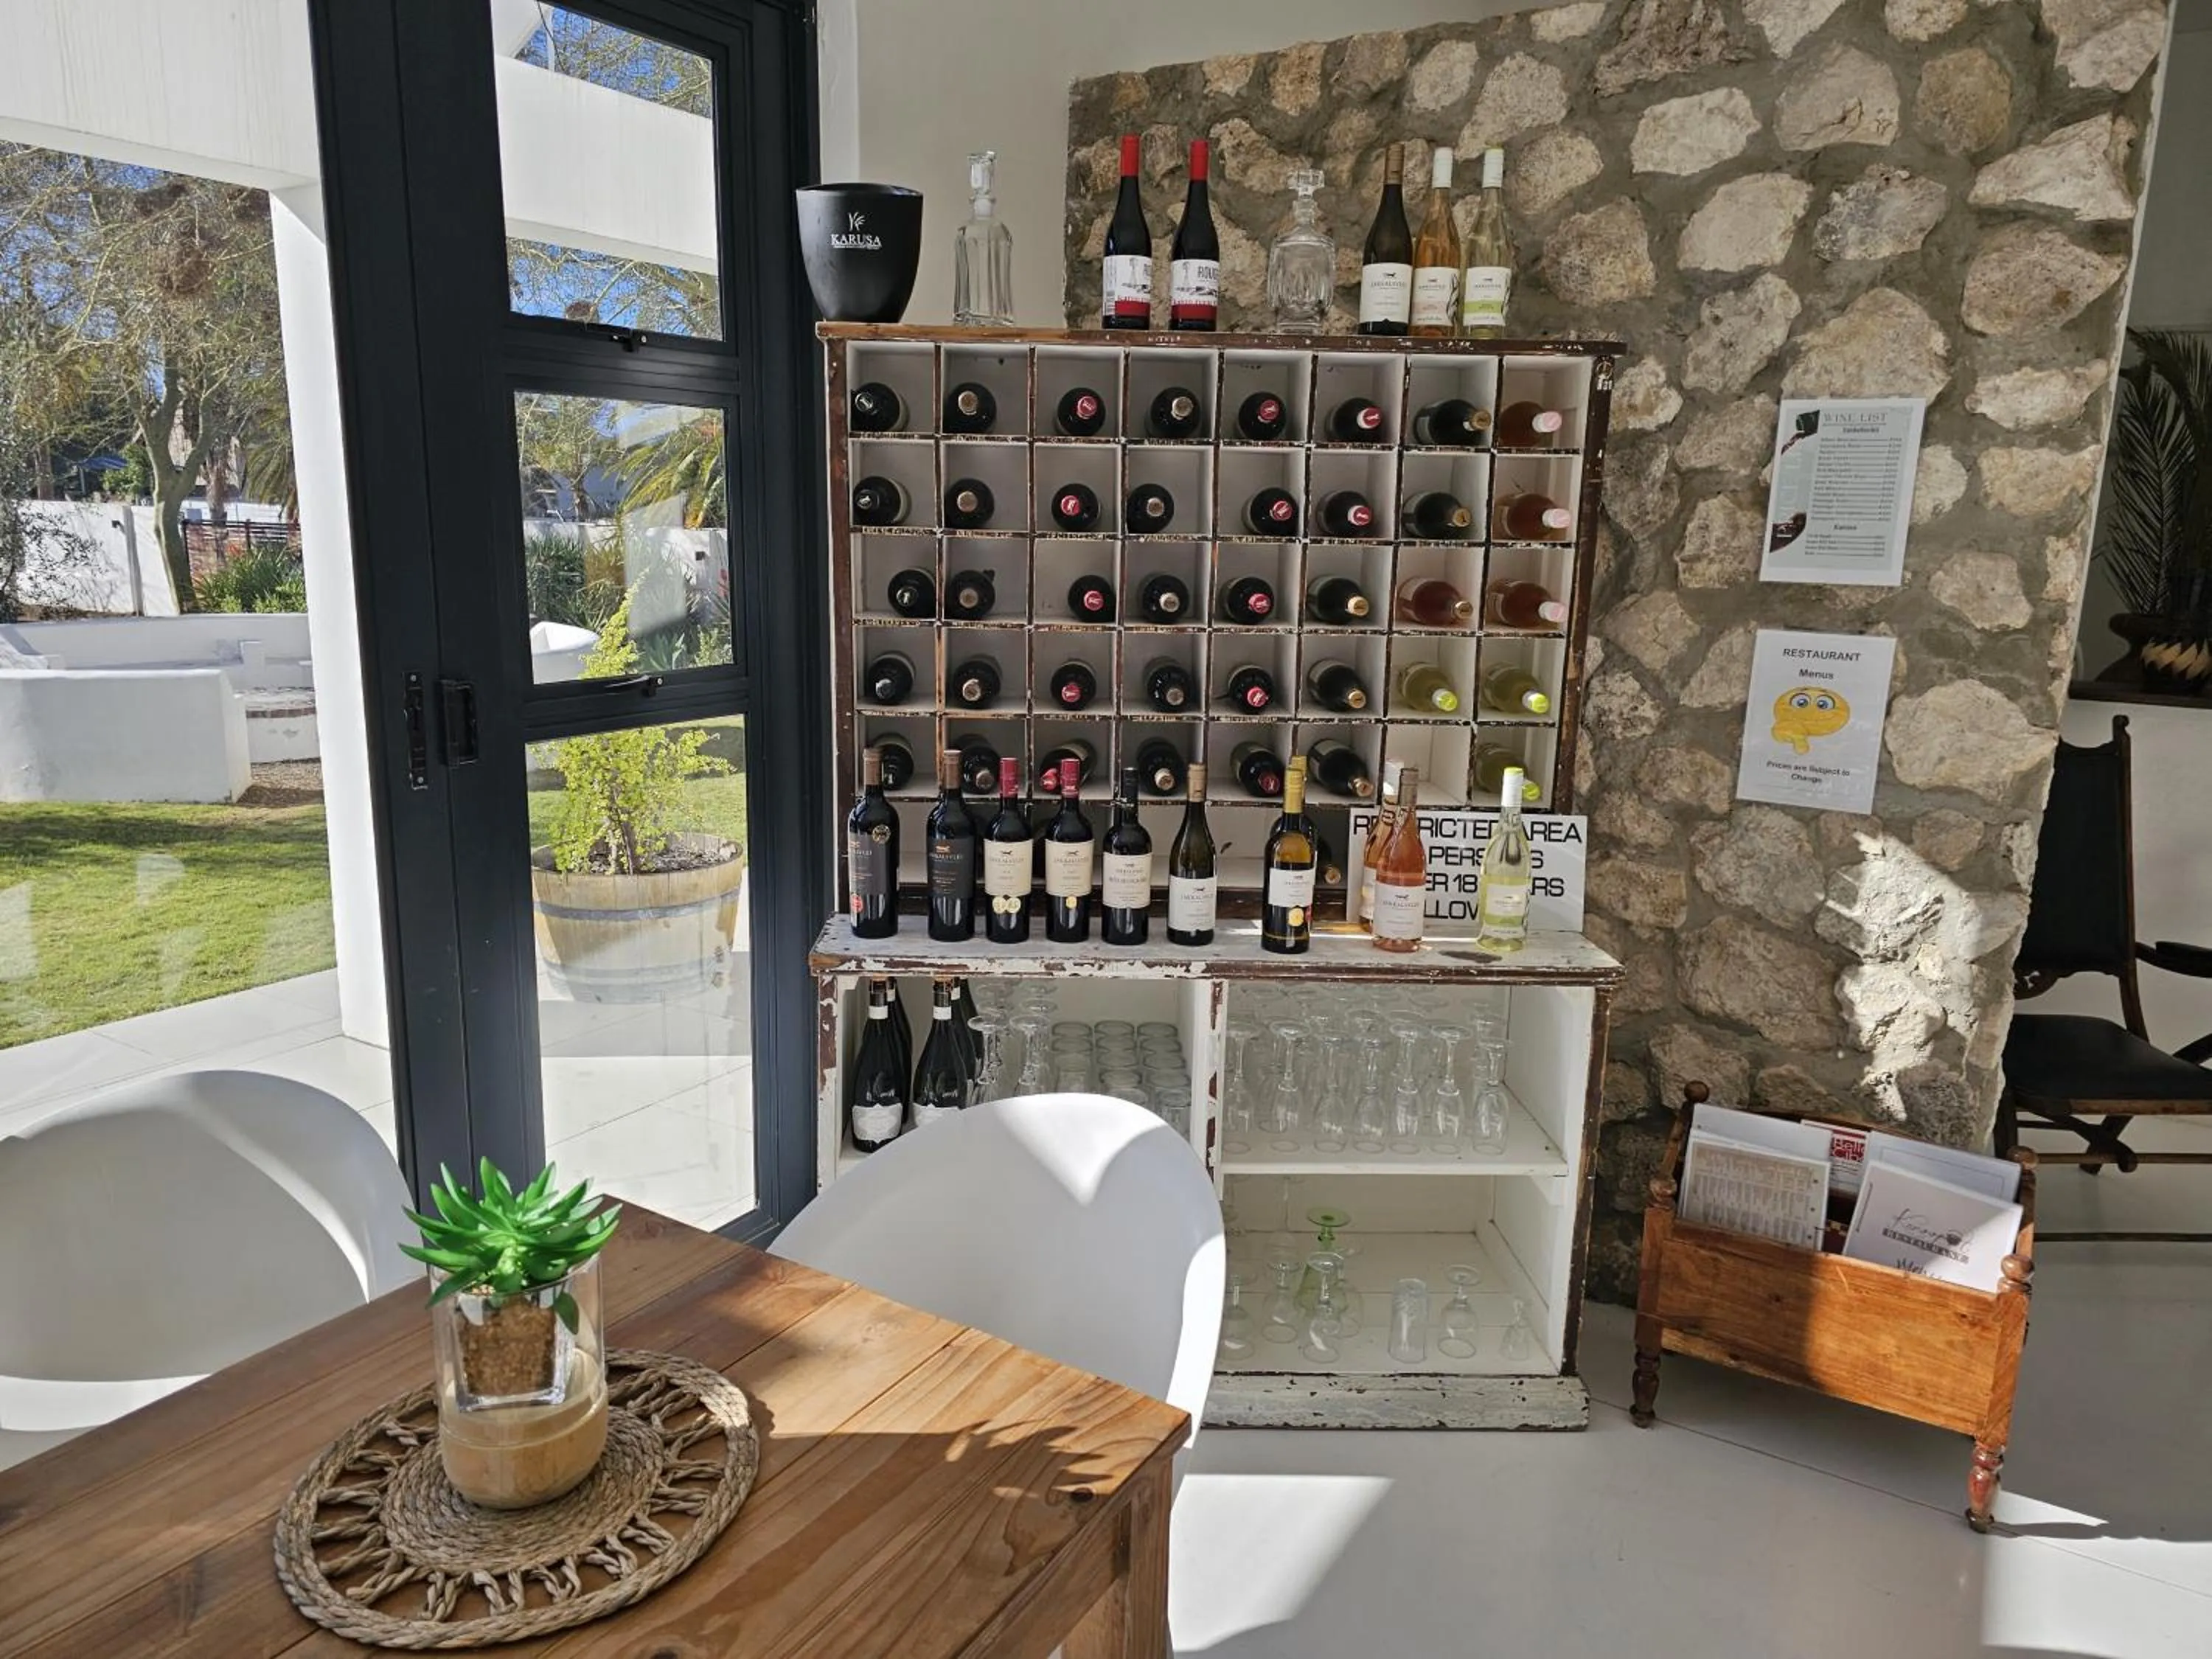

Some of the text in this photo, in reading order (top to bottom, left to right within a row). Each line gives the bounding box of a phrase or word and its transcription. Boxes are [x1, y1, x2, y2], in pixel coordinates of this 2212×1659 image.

[830, 234, 883, 248] KARUSA
[1783, 648, 1860, 661] RESTAURANT
[1799, 668, 1834, 679] Menus
[1453, 874, 1478, 894] 18
